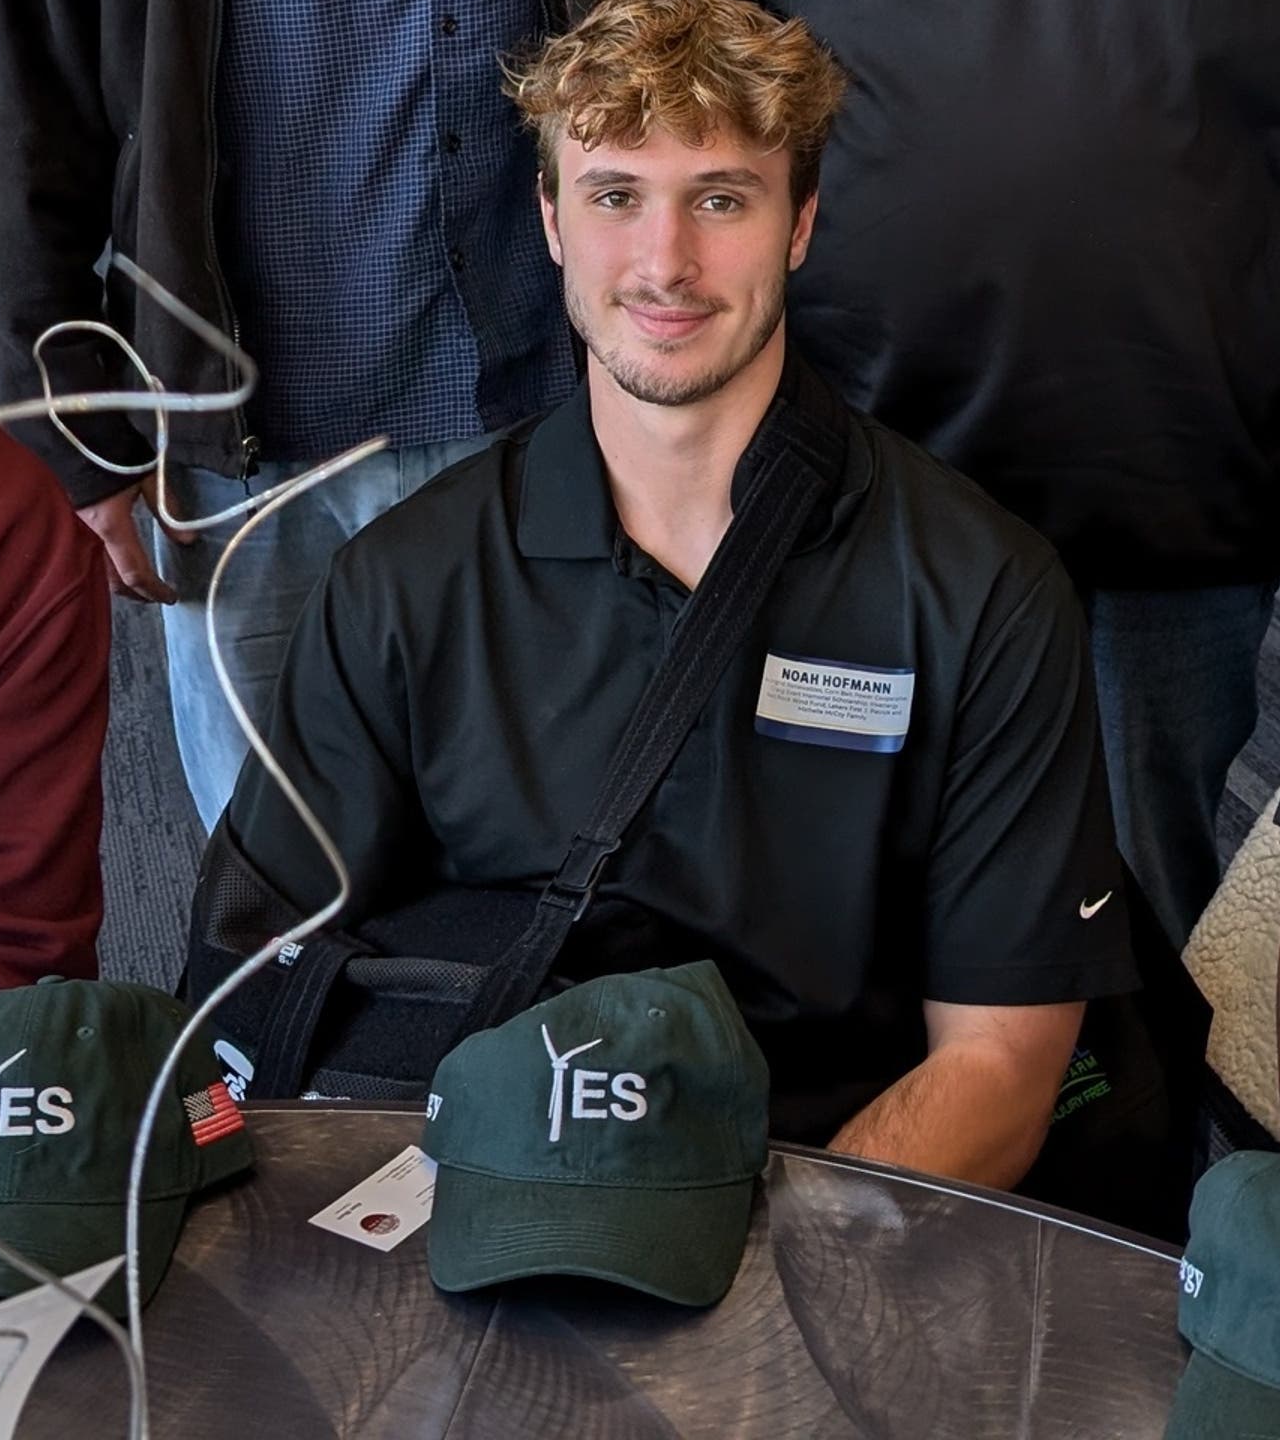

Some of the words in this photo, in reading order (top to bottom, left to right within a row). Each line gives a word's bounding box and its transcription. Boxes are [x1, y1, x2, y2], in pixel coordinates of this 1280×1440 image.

[781, 668, 820, 685] NOAH
[822, 674, 892, 695] HOFMANN
[540, 1023, 649, 1143] YES
